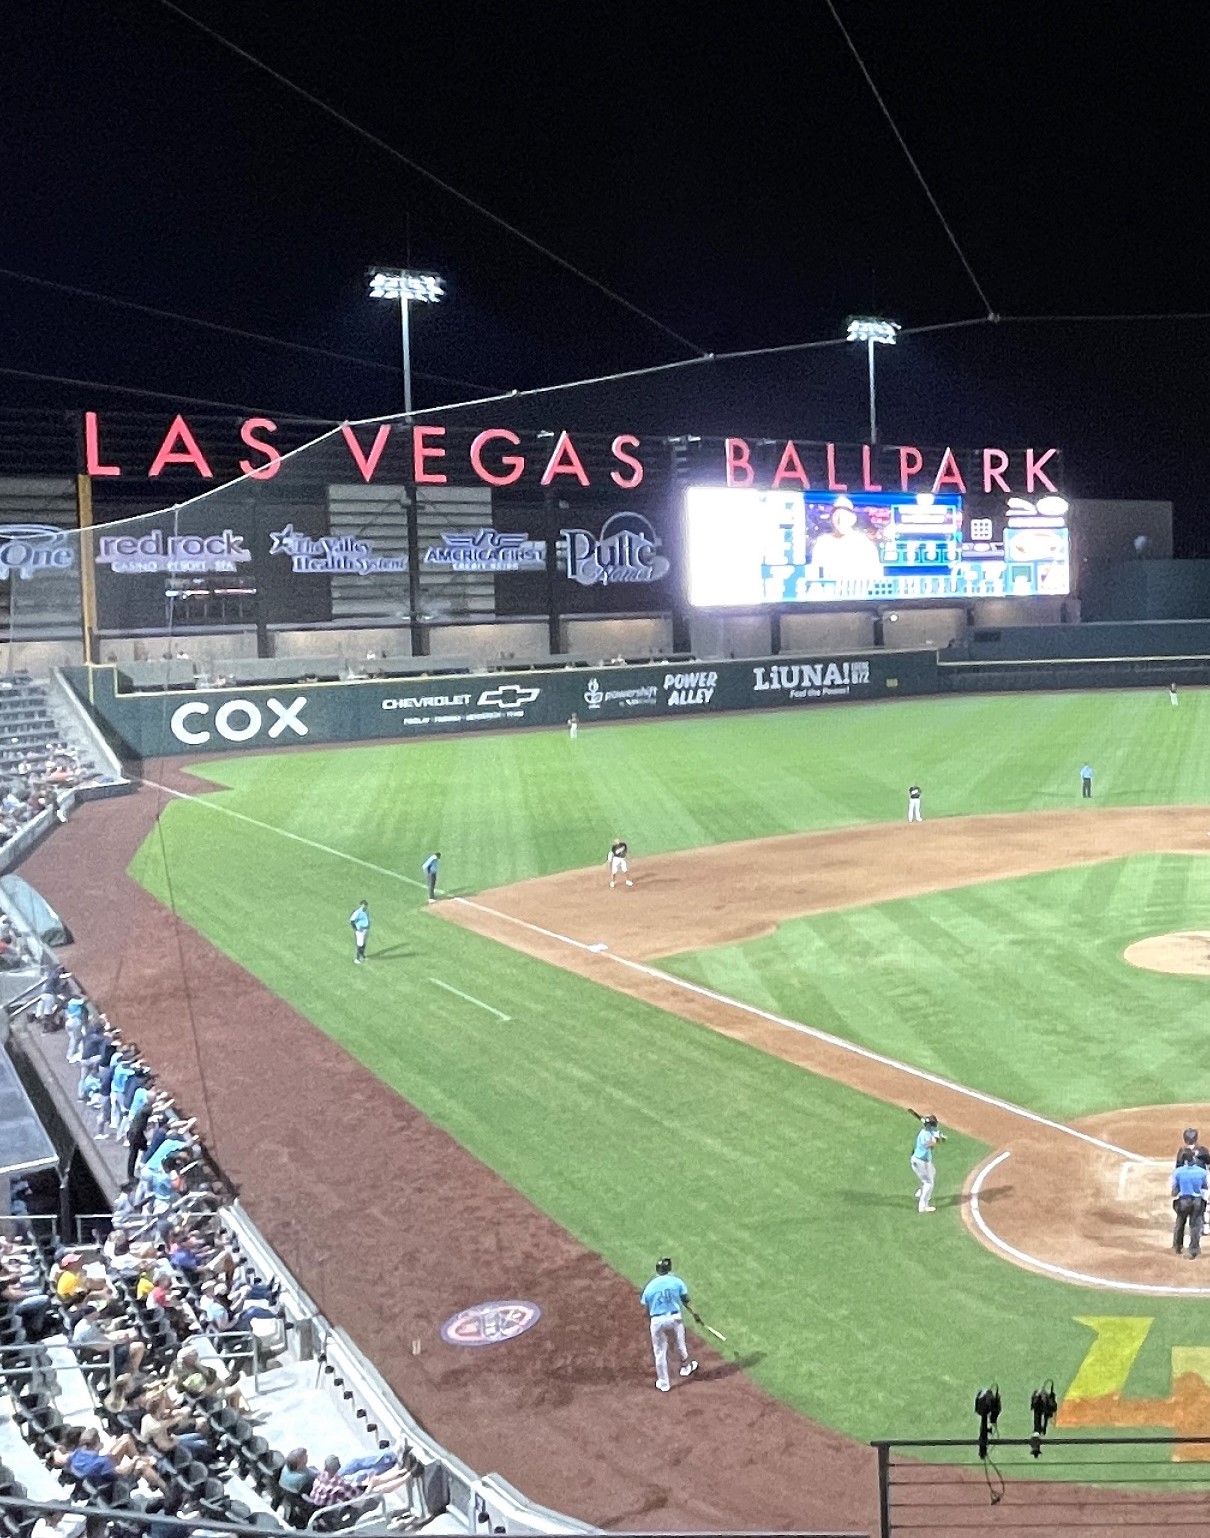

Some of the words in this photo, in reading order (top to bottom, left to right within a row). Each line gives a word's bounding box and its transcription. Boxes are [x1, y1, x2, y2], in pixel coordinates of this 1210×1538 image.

[84, 411, 282, 481] LAS
[340, 420, 643, 489] VEGAS
[725, 437, 1058, 493] BALLPARK
[102, 531, 163, 556] red
[168, 530, 243, 556] rock
[426, 548, 499, 562] AMERICA
[664, 672, 718, 690] POWER
[381, 694, 472, 710] CHEVROLET
[668, 688, 714, 706] ALLEY
[170, 697, 309, 745] COX
